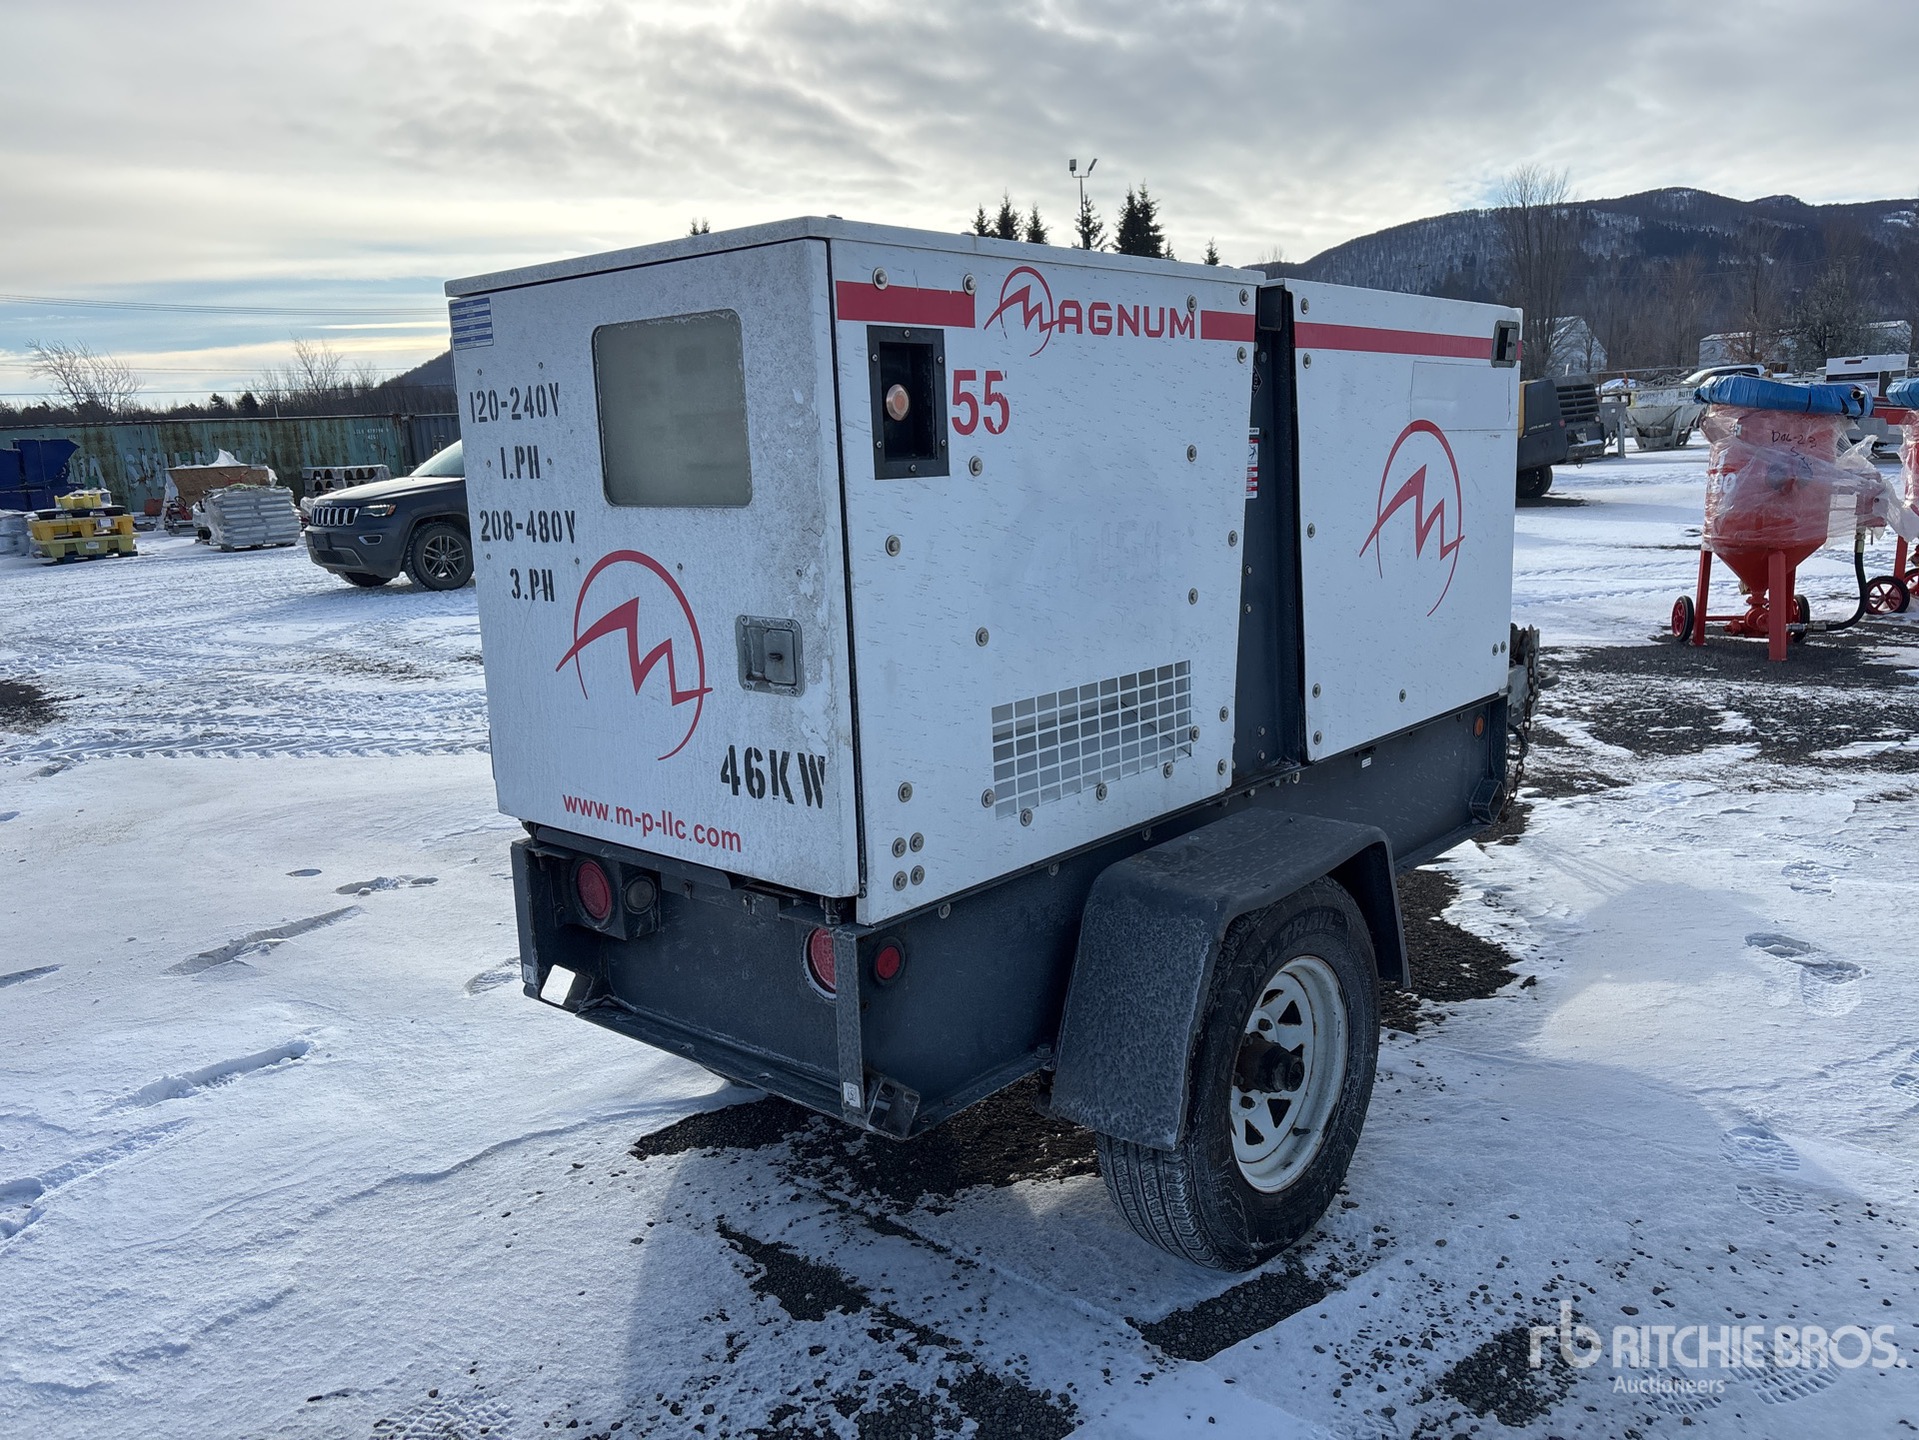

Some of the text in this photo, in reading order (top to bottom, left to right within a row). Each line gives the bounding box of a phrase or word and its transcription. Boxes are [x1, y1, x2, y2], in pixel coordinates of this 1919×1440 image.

[983, 282, 1196, 340] MAGNUM
[470, 383, 559, 423] 120-240V
[952, 370, 1010, 436] 55
[500, 446, 541, 480] 1.PH
[479, 509, 576, 544] 208-480V
[509, 568, 556, 603] 3.PH
[720, 744, 826, 810] 46KW
[563, 794, 742, 852] www.m-p-llc.com
